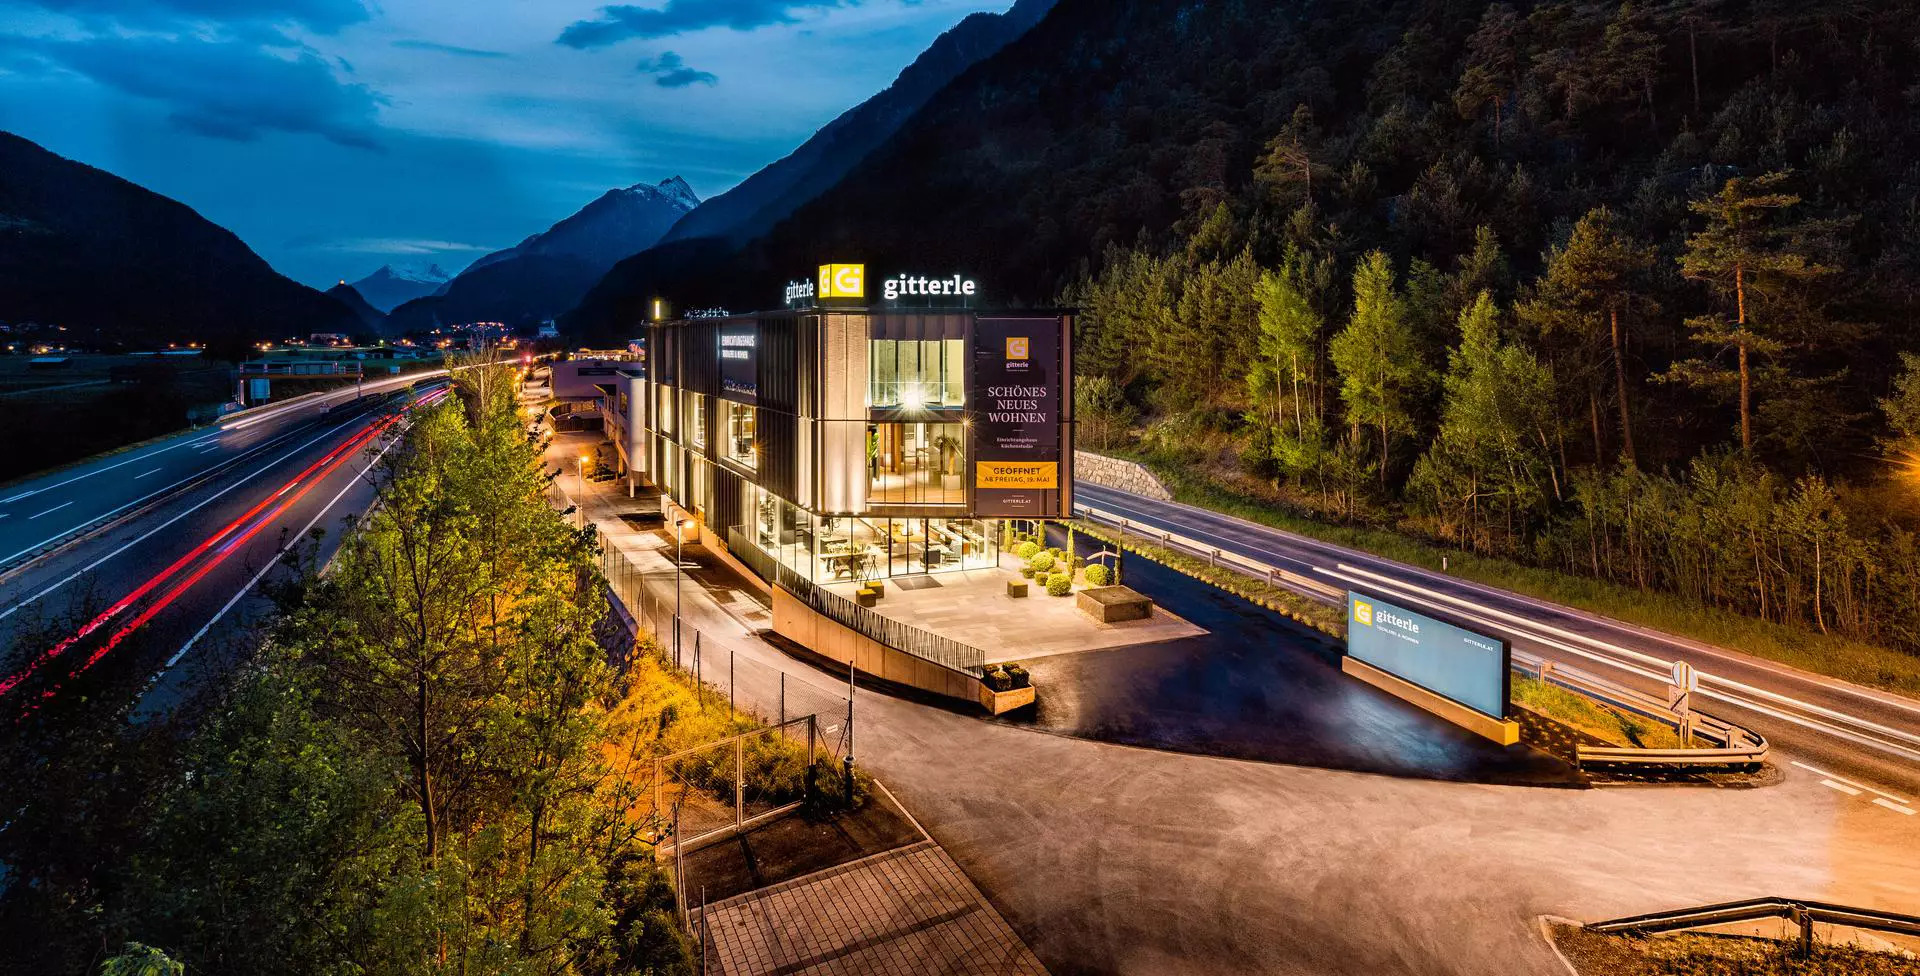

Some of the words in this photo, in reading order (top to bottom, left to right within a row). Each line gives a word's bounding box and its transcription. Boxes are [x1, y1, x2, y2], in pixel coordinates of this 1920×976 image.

[786, 278, 814, 304] gitterle
[884, 274, 975, 299] gitterle
[988, 385, 1047, 397] SCHÖNES
[997, 400, 1038, 410] NEUES
[988, 412, 1047, 424] WOHNEN
[1376, 610, 1419, 633] gitterle
